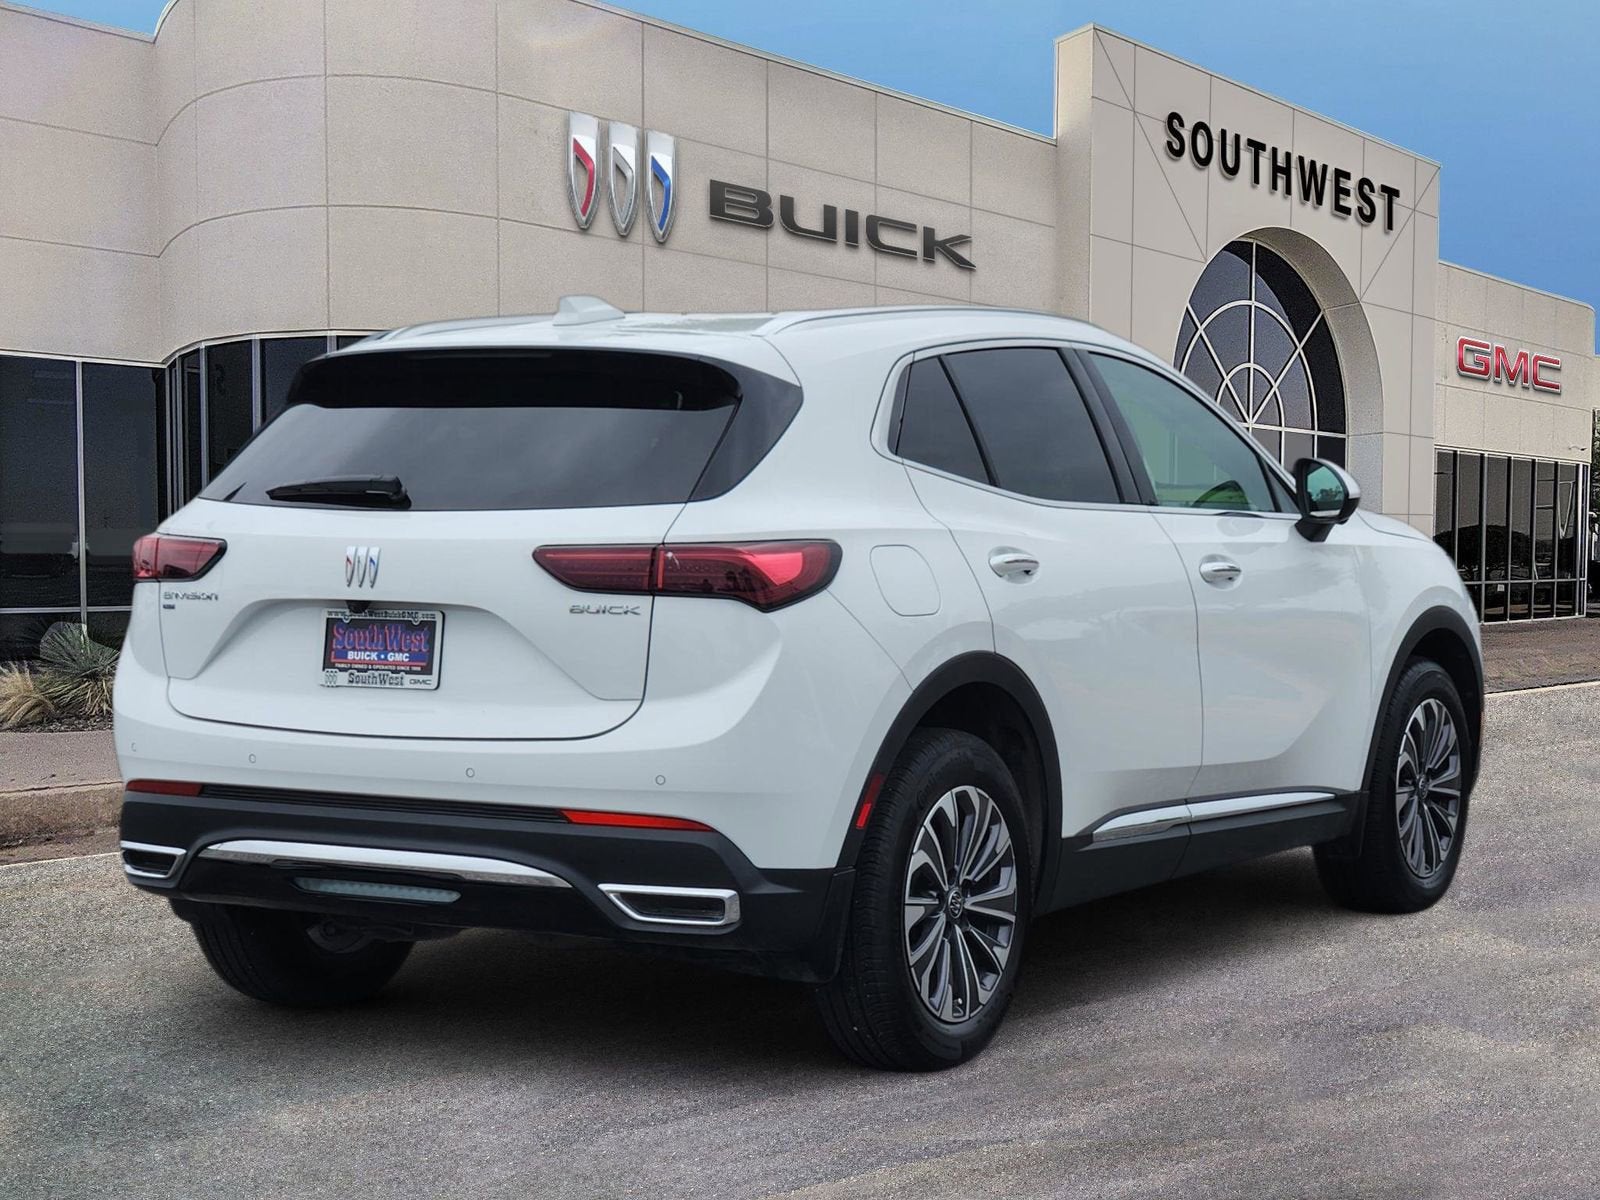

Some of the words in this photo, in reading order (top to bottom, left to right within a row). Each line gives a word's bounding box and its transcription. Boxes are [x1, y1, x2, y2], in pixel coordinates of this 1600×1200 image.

[1166, 111, 1400, 233] SOUTHWEST
[709, 179, 977, 271] BUICK
[1457, 336, 1561, 395] GMC
[569, 605, 641, 616] BUICK
[347, 651, 378, 661] BUICK
[387, 652, 410, 662] GMC
[409, 678, 433, 686] GMC
